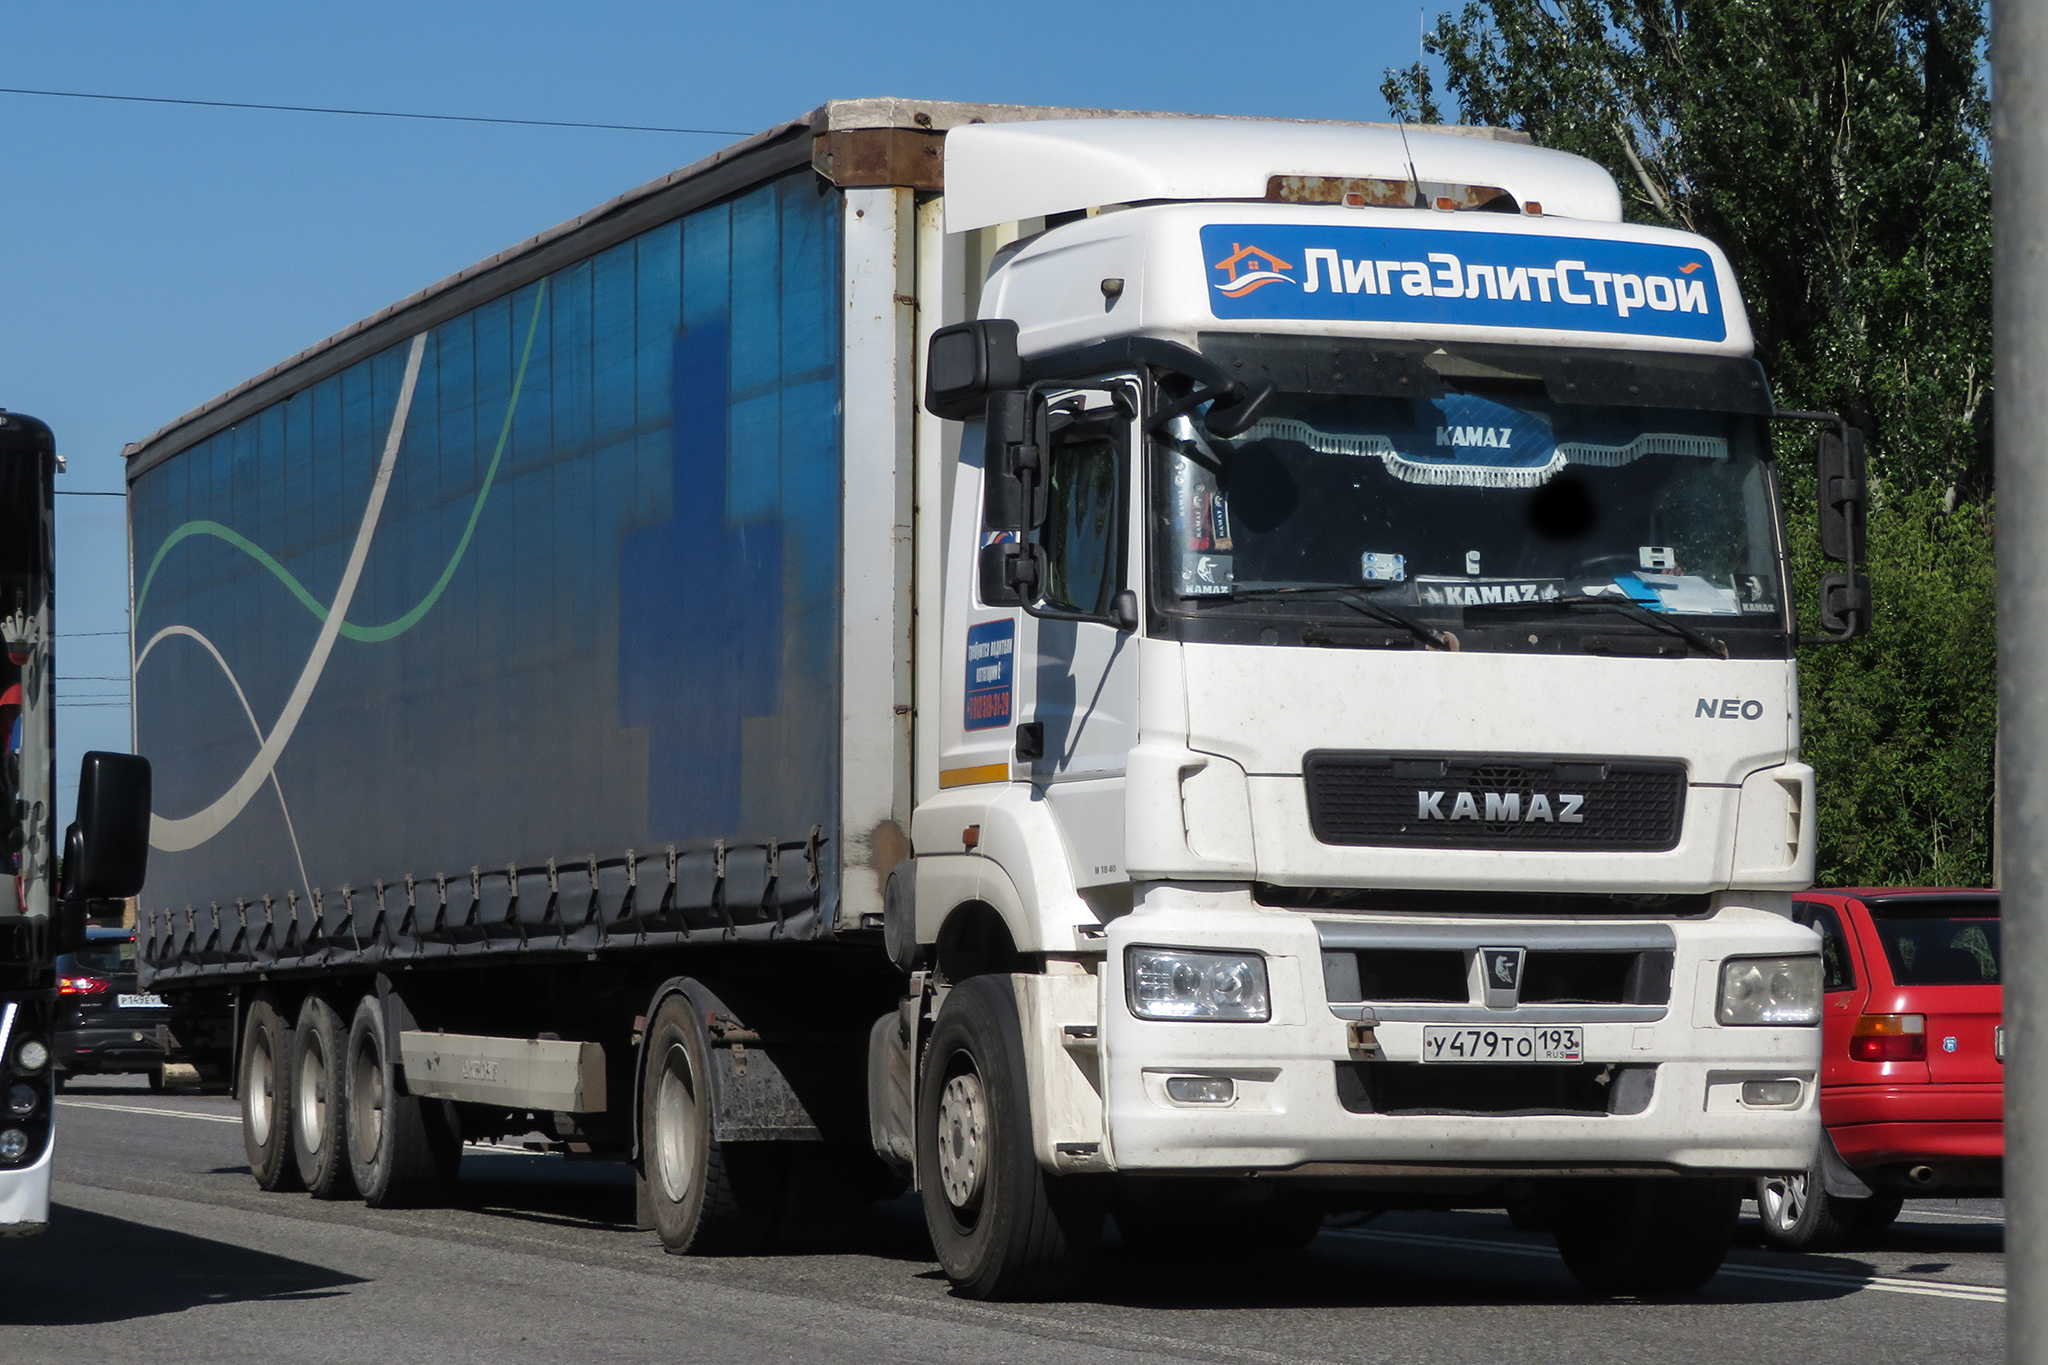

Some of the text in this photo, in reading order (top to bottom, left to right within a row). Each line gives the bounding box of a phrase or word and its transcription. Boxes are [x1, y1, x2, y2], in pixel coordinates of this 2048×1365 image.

[1303, 248, 1709, 317] ЛигаЭлитСтрой
[1436, 426, 1512, 448] KAMAZ
[1185, 584, 1229, 594] KAMAZ
[1444, 585, 1539, 605] KAMAZ
[1741, 603, 1775, 613] KAMAZ
[1695, 698, 1764, 720] NEO
[1417, 790, 1585, 824] KAMAZ
[1537, 1030, 1575, 1050] 193
[1546, 1051, 1565, 1059] RUS
